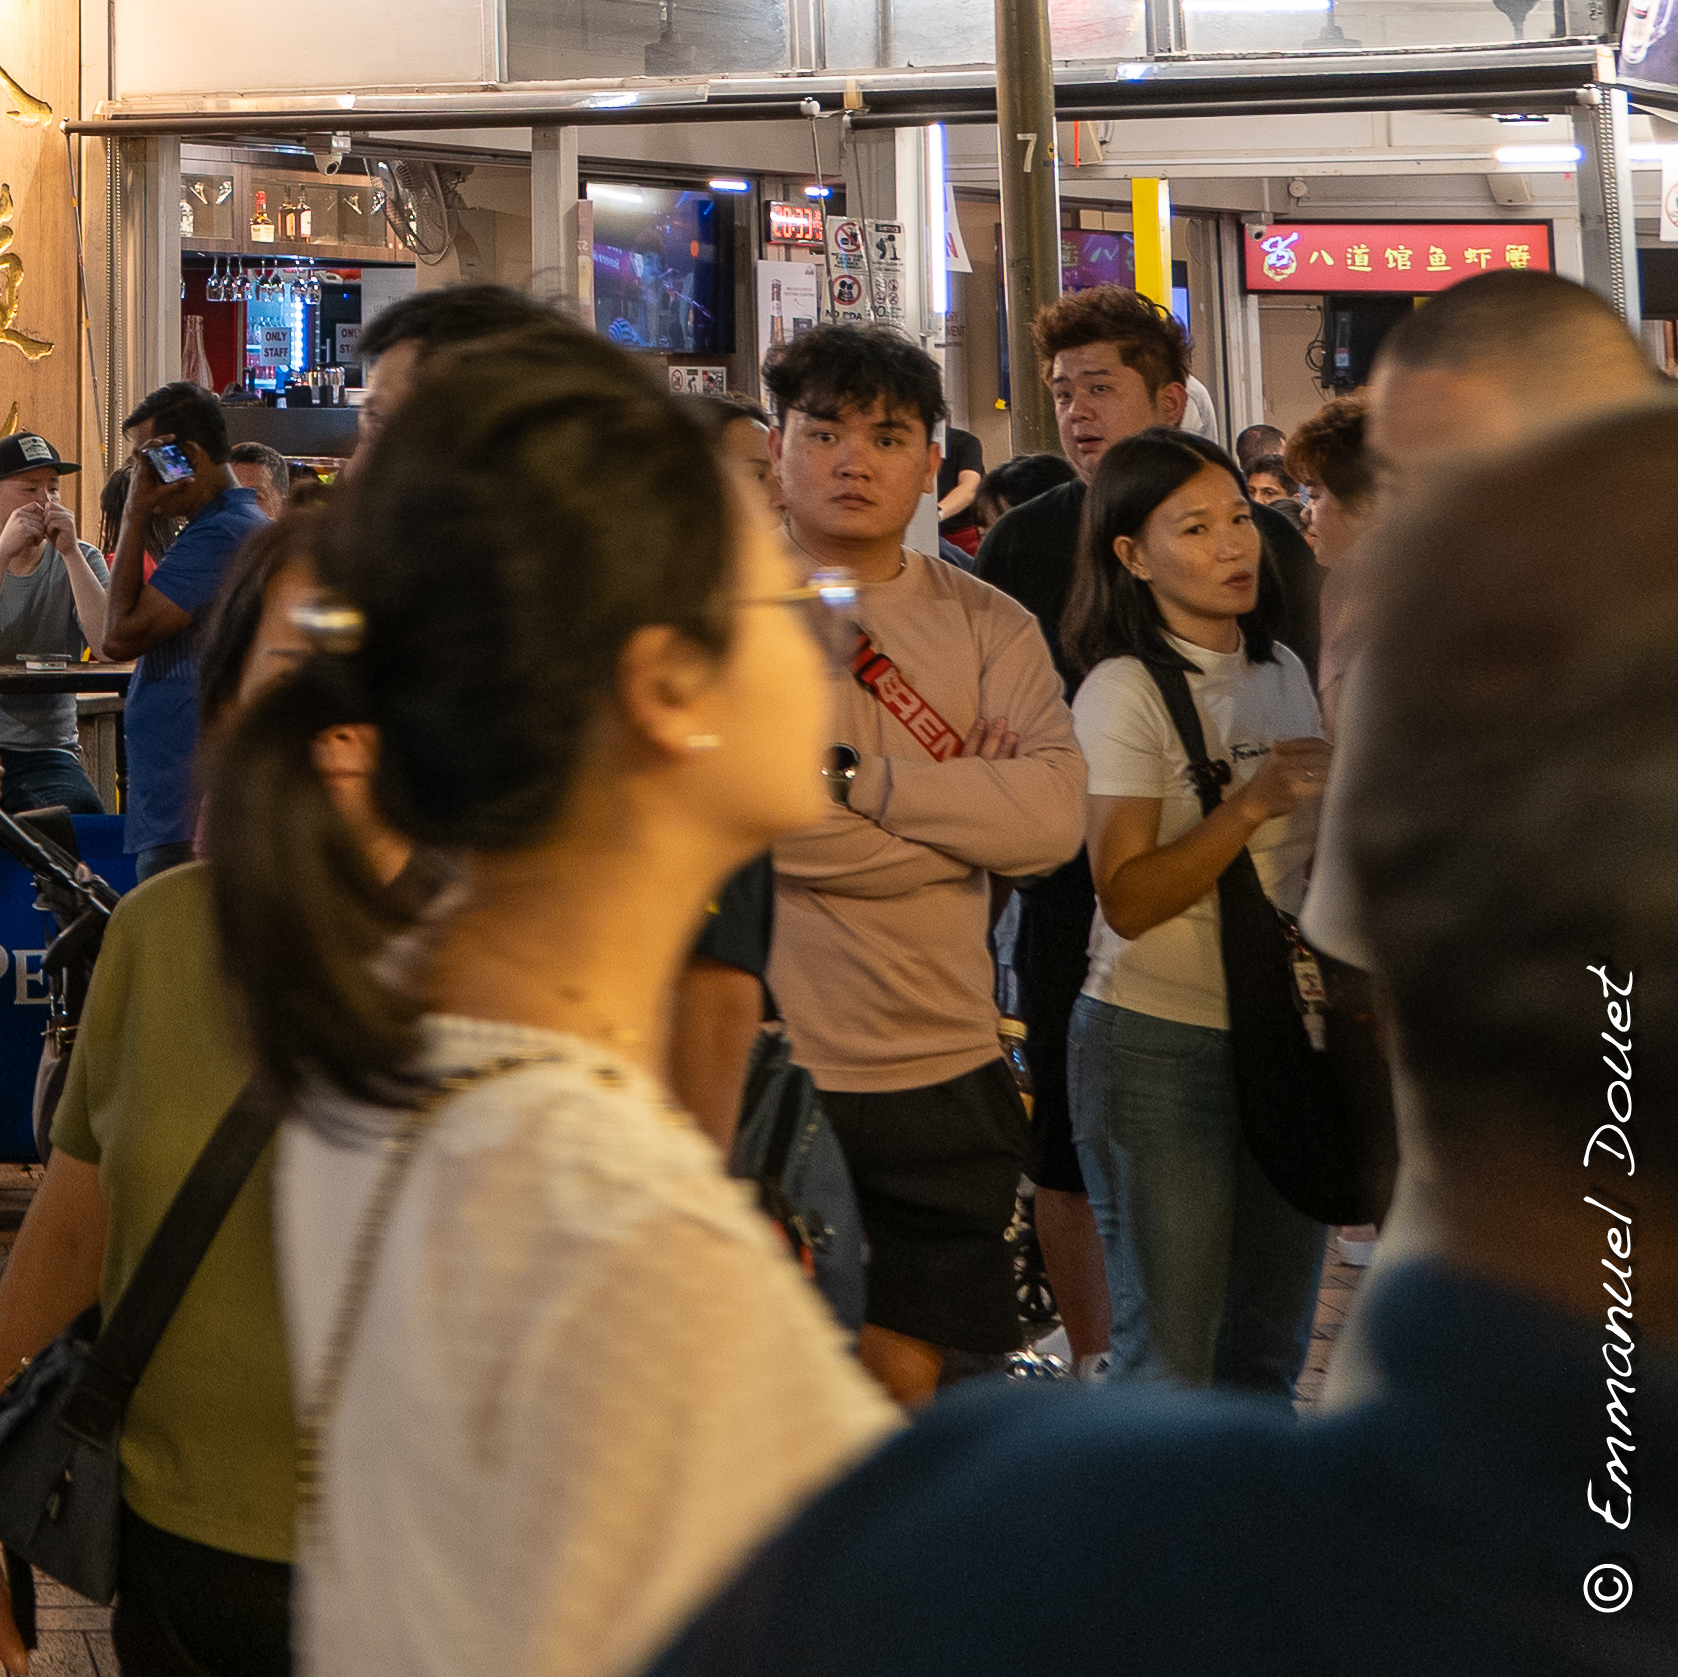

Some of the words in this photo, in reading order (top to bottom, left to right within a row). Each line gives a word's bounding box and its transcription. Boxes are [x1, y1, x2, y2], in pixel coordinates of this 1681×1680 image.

[1017, 133, 1037, 173] 7
[265, 331, 288, 341] ONLY
[263, 347, 289, 358] STAFF
